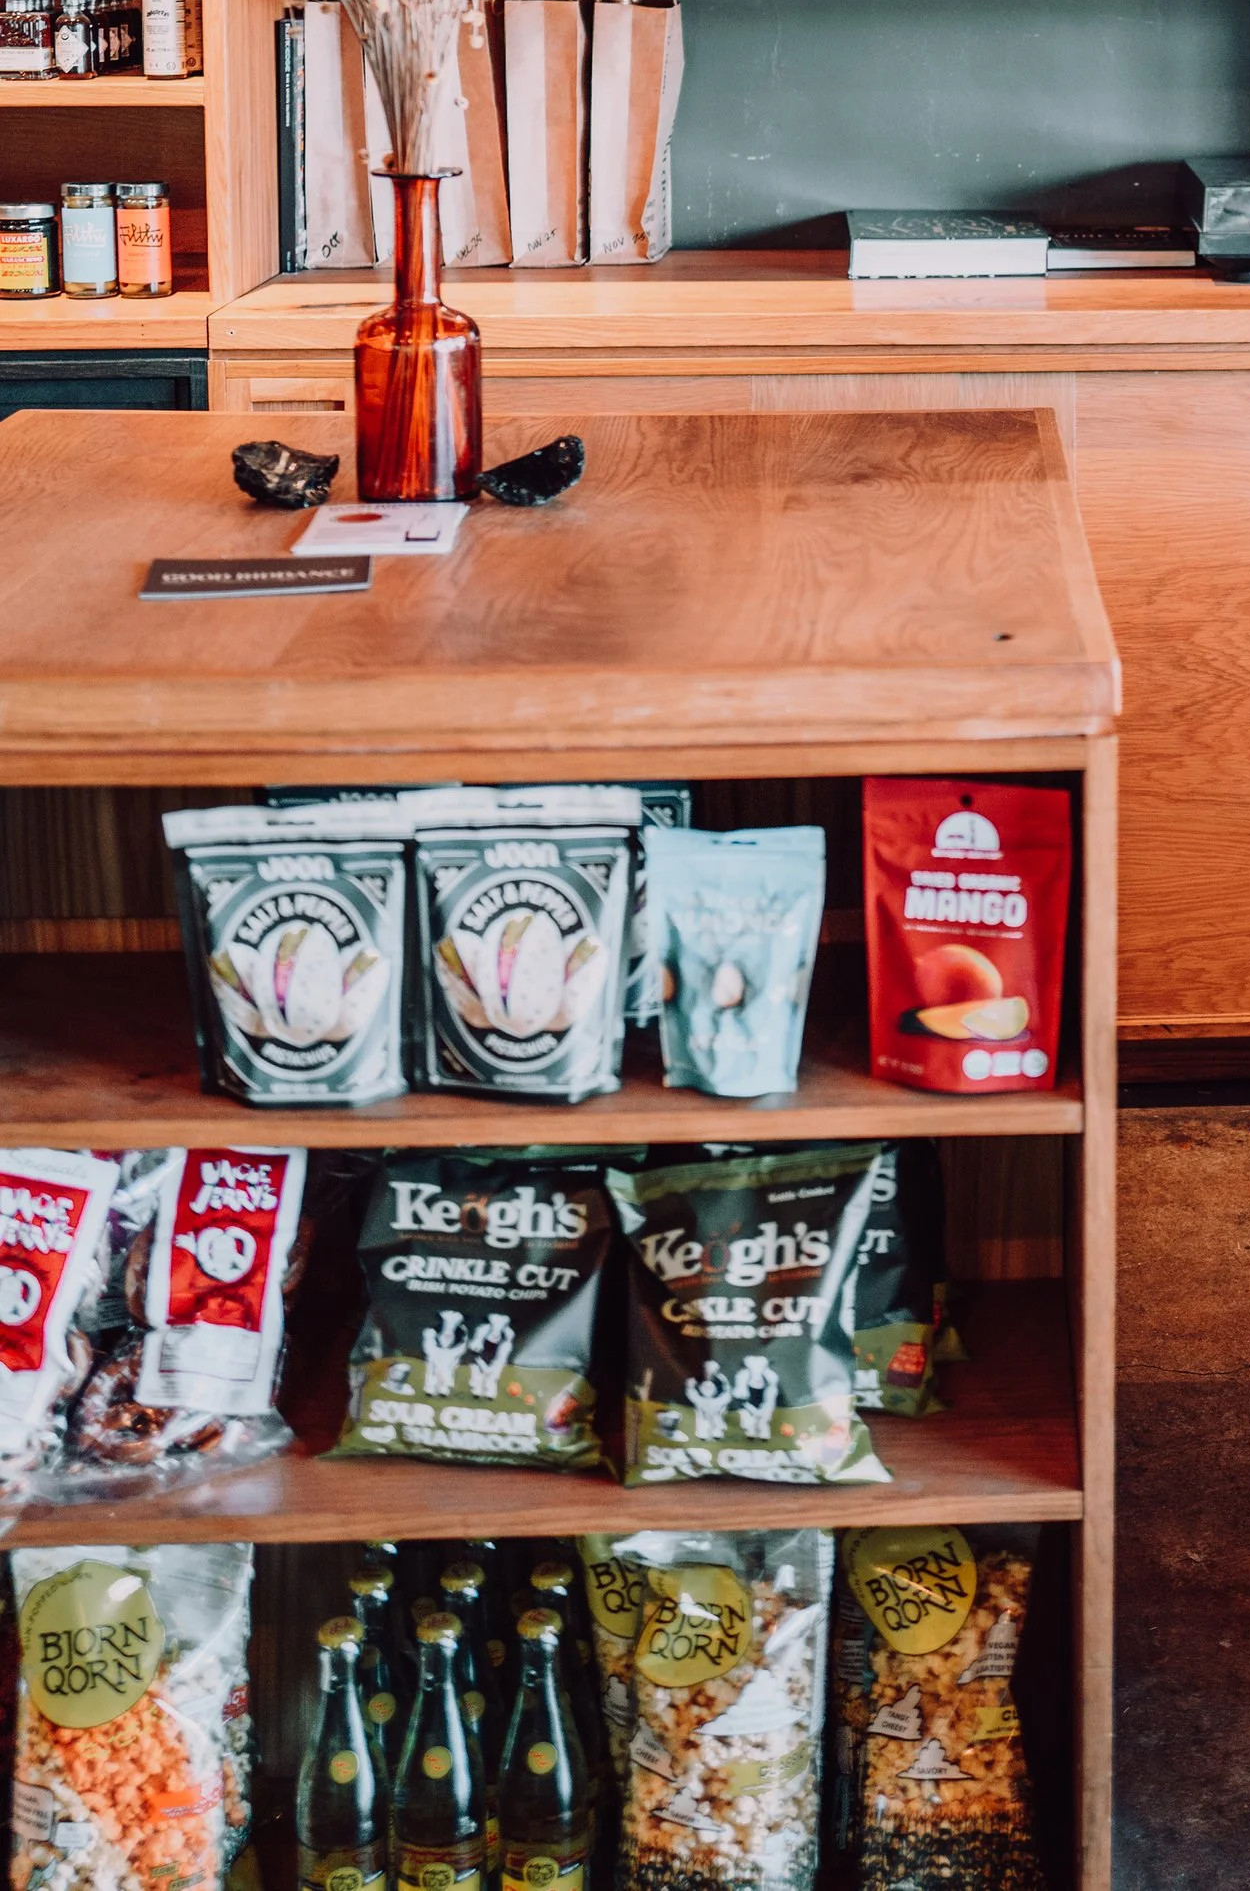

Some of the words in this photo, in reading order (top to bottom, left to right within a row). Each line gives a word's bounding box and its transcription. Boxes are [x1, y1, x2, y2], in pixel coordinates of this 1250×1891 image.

[64, 221, 107, 248] Filthy
[119, 222, 164, 248] Filthy
[237, 897, 281, 946] SALT
[293, 892, 356, 944] PEPPER
[463, 885, 505, 932] SALT
[518, 880, 579, 929] PEPPER
[904, 885, 1028, 928] MANGO
[389, 1180, 588, 1249] Keogh's
[381, 1254, 512, 1285] CRINKLE
[516, 1264, 580, 1292] CUT
[640, 1220, 831, 1288] Keogh's
[406, 1278, 446, 1293] IRISH
[449, 1282, 506, 1299] POTATO
[508, 1287, 548, 1301] CHIPS
[369, 1399, 436, 1428] SOUR
[440, 1406, 537, 1437] CREAM
[865, 1541, 963, 1608] BJORN
[882, 1573, 969, 1632] QORN
[39, 1616, 150, 1669] BJORN
[650, 1627, 739, 1666] QORN
[43, 1653, 144, 1697] QORN
